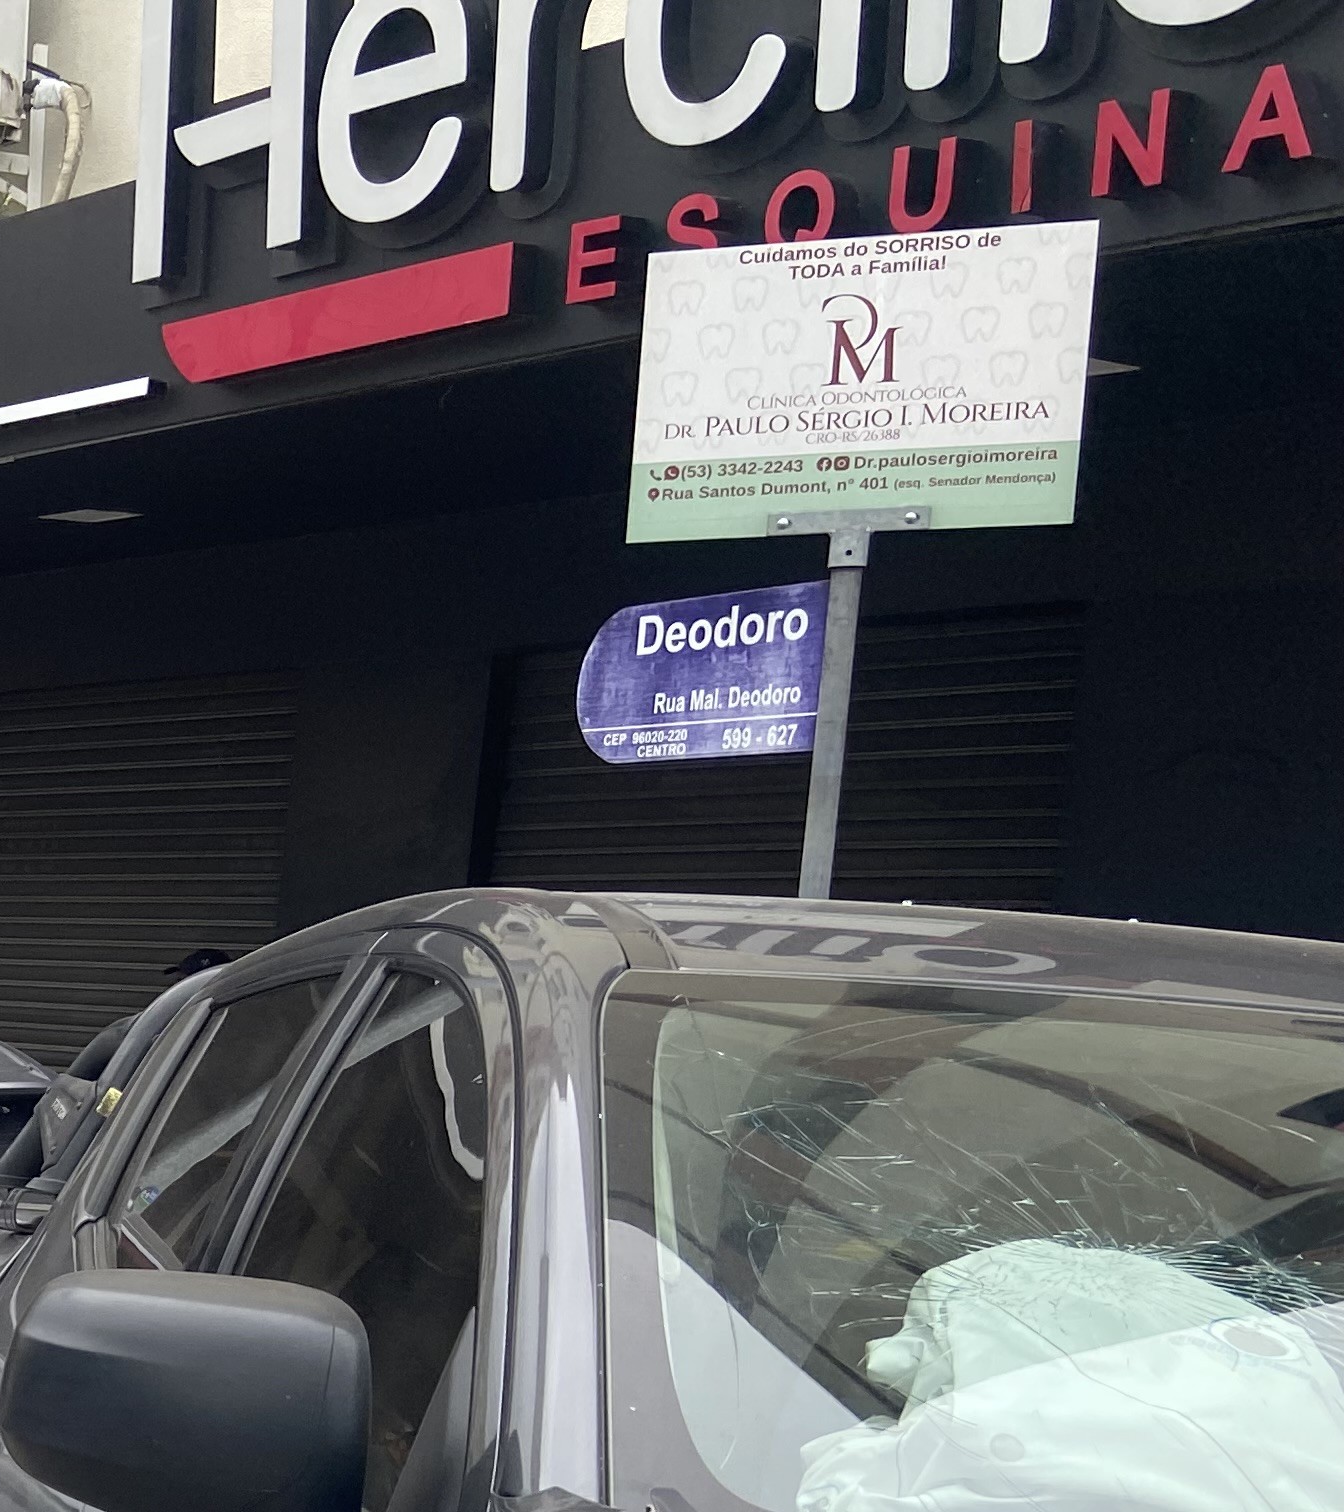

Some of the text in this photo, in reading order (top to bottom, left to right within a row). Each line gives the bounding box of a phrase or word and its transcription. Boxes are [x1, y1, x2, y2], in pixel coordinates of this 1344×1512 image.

[566, 62, 1314, 306] ESQUINA
[739, 232, 1002, 265] Cuidamos do SORRISO de
[788, 256, 947, 281] TODA a Família!
[747, 385, 967, 411] CLÍNICA ODONTOLÓGICA
[705, 414, 790, 437] PAULO
[796, 406, 893, 433] SÉRGIO
[901, 406, 912, 426] I.
[921, 401, 1050, 425] MOREIRA
[681, 464, 712, 481] (53)
[717, 459, 804, 477] 3342-2243
[662, 487, 693, 501] Rua
[698, 484, 756, 499] Santos
[761, 480, 831, 496] Dumont,
[859, 477, 888, 490] 401
[893, 477, 924, 492] (esq.
[928, 475, 982, 487] Senador
[985, 471, 1056, 486] Mendonça)
[636, 604, 810, 656] Deodoro
[653, 683, 801, 714] Rua Mal. Deodoro
[603, 728, 688, 747] CEP 96020-220
[637, 743, 687, 758] CENTRO
[721, 727, 752, 750] 599
[767, 723, 799, 747] 627
